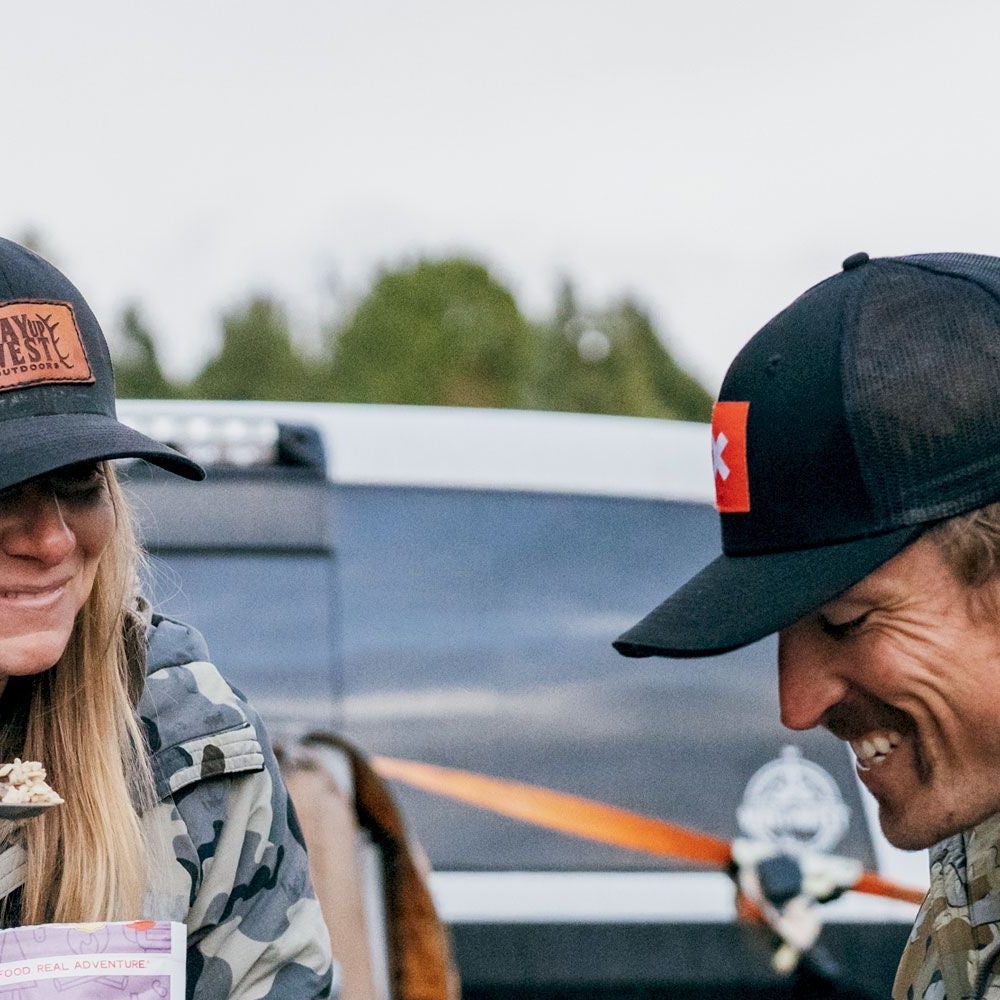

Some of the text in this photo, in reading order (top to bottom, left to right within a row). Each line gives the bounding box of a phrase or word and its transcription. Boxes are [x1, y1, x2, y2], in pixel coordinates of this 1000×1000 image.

[27, 319, 46, 338] UP
[37, 962, 69, 973] REAL
[74, 959, 146, 970] ADVENTURE
